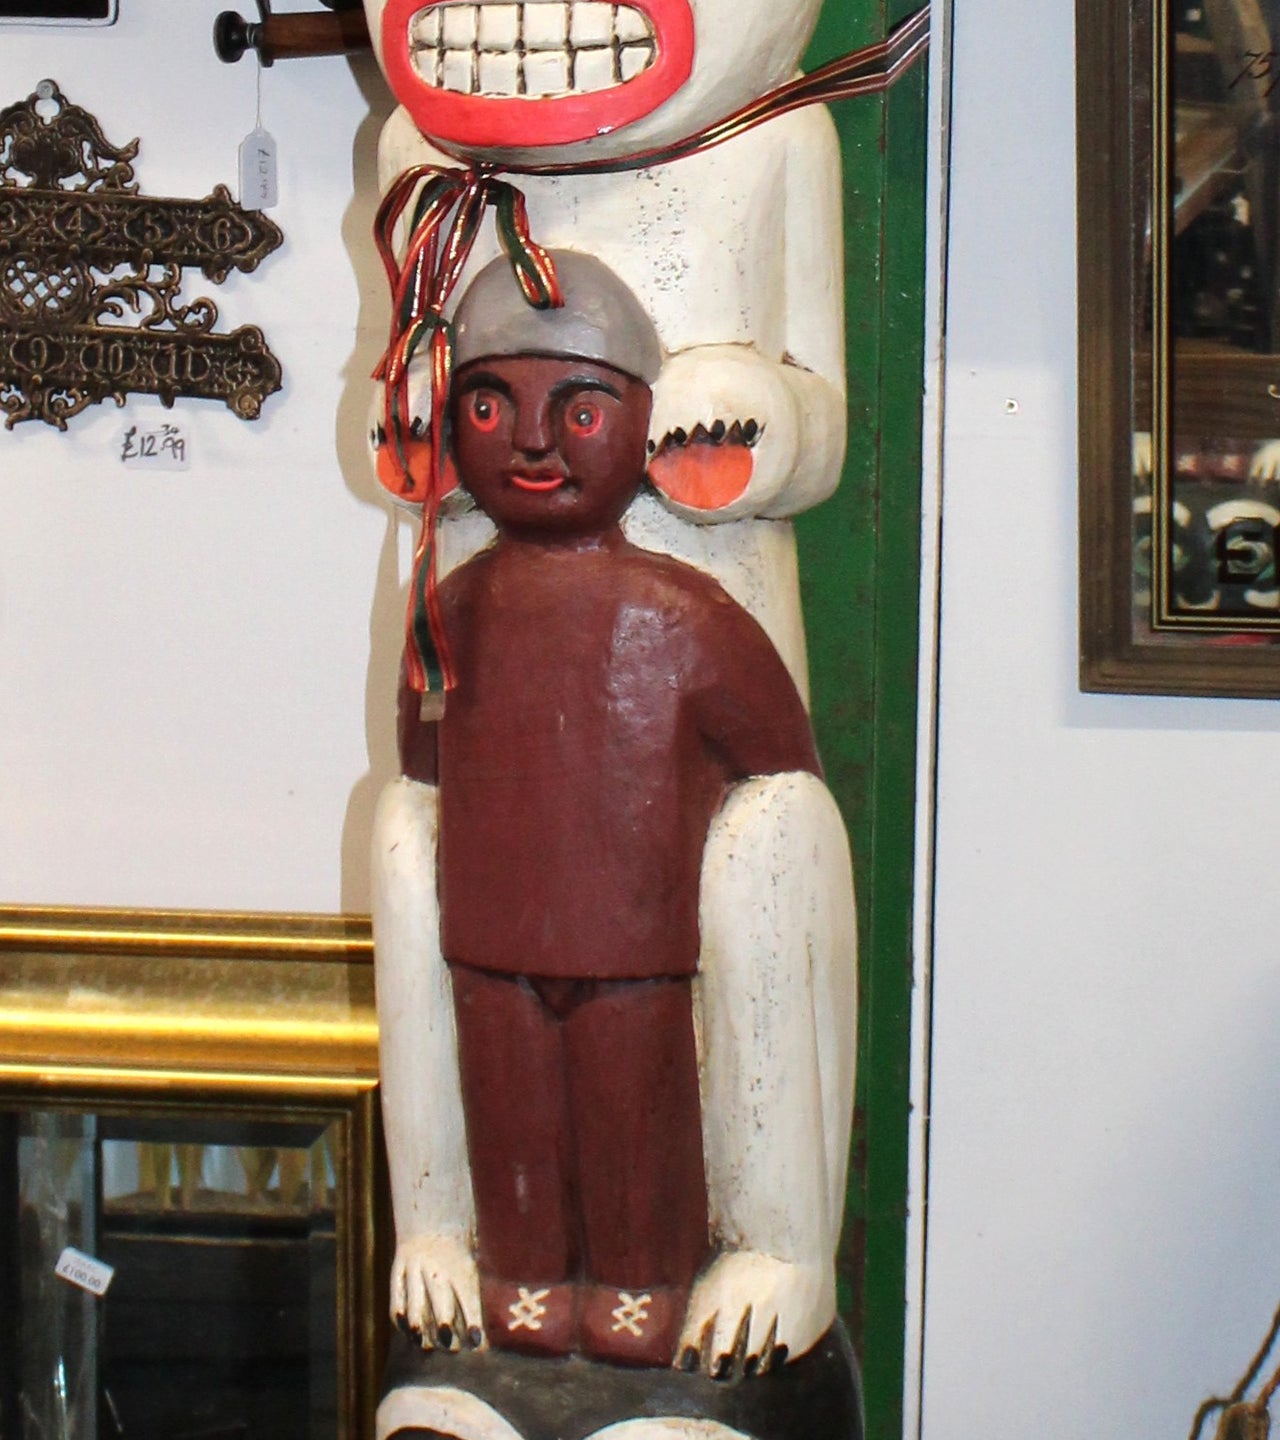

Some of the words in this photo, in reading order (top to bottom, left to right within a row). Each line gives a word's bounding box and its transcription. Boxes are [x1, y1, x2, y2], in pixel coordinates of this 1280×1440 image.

[65, 206, 85, 233] 4
[143, 209, 162, 242] 5
[214, 218, 233, 249] 6
[30, 337, 48, 370] 9
[97, 342, 123, 373] 10
[121, 426, 186, 462] £12.99
